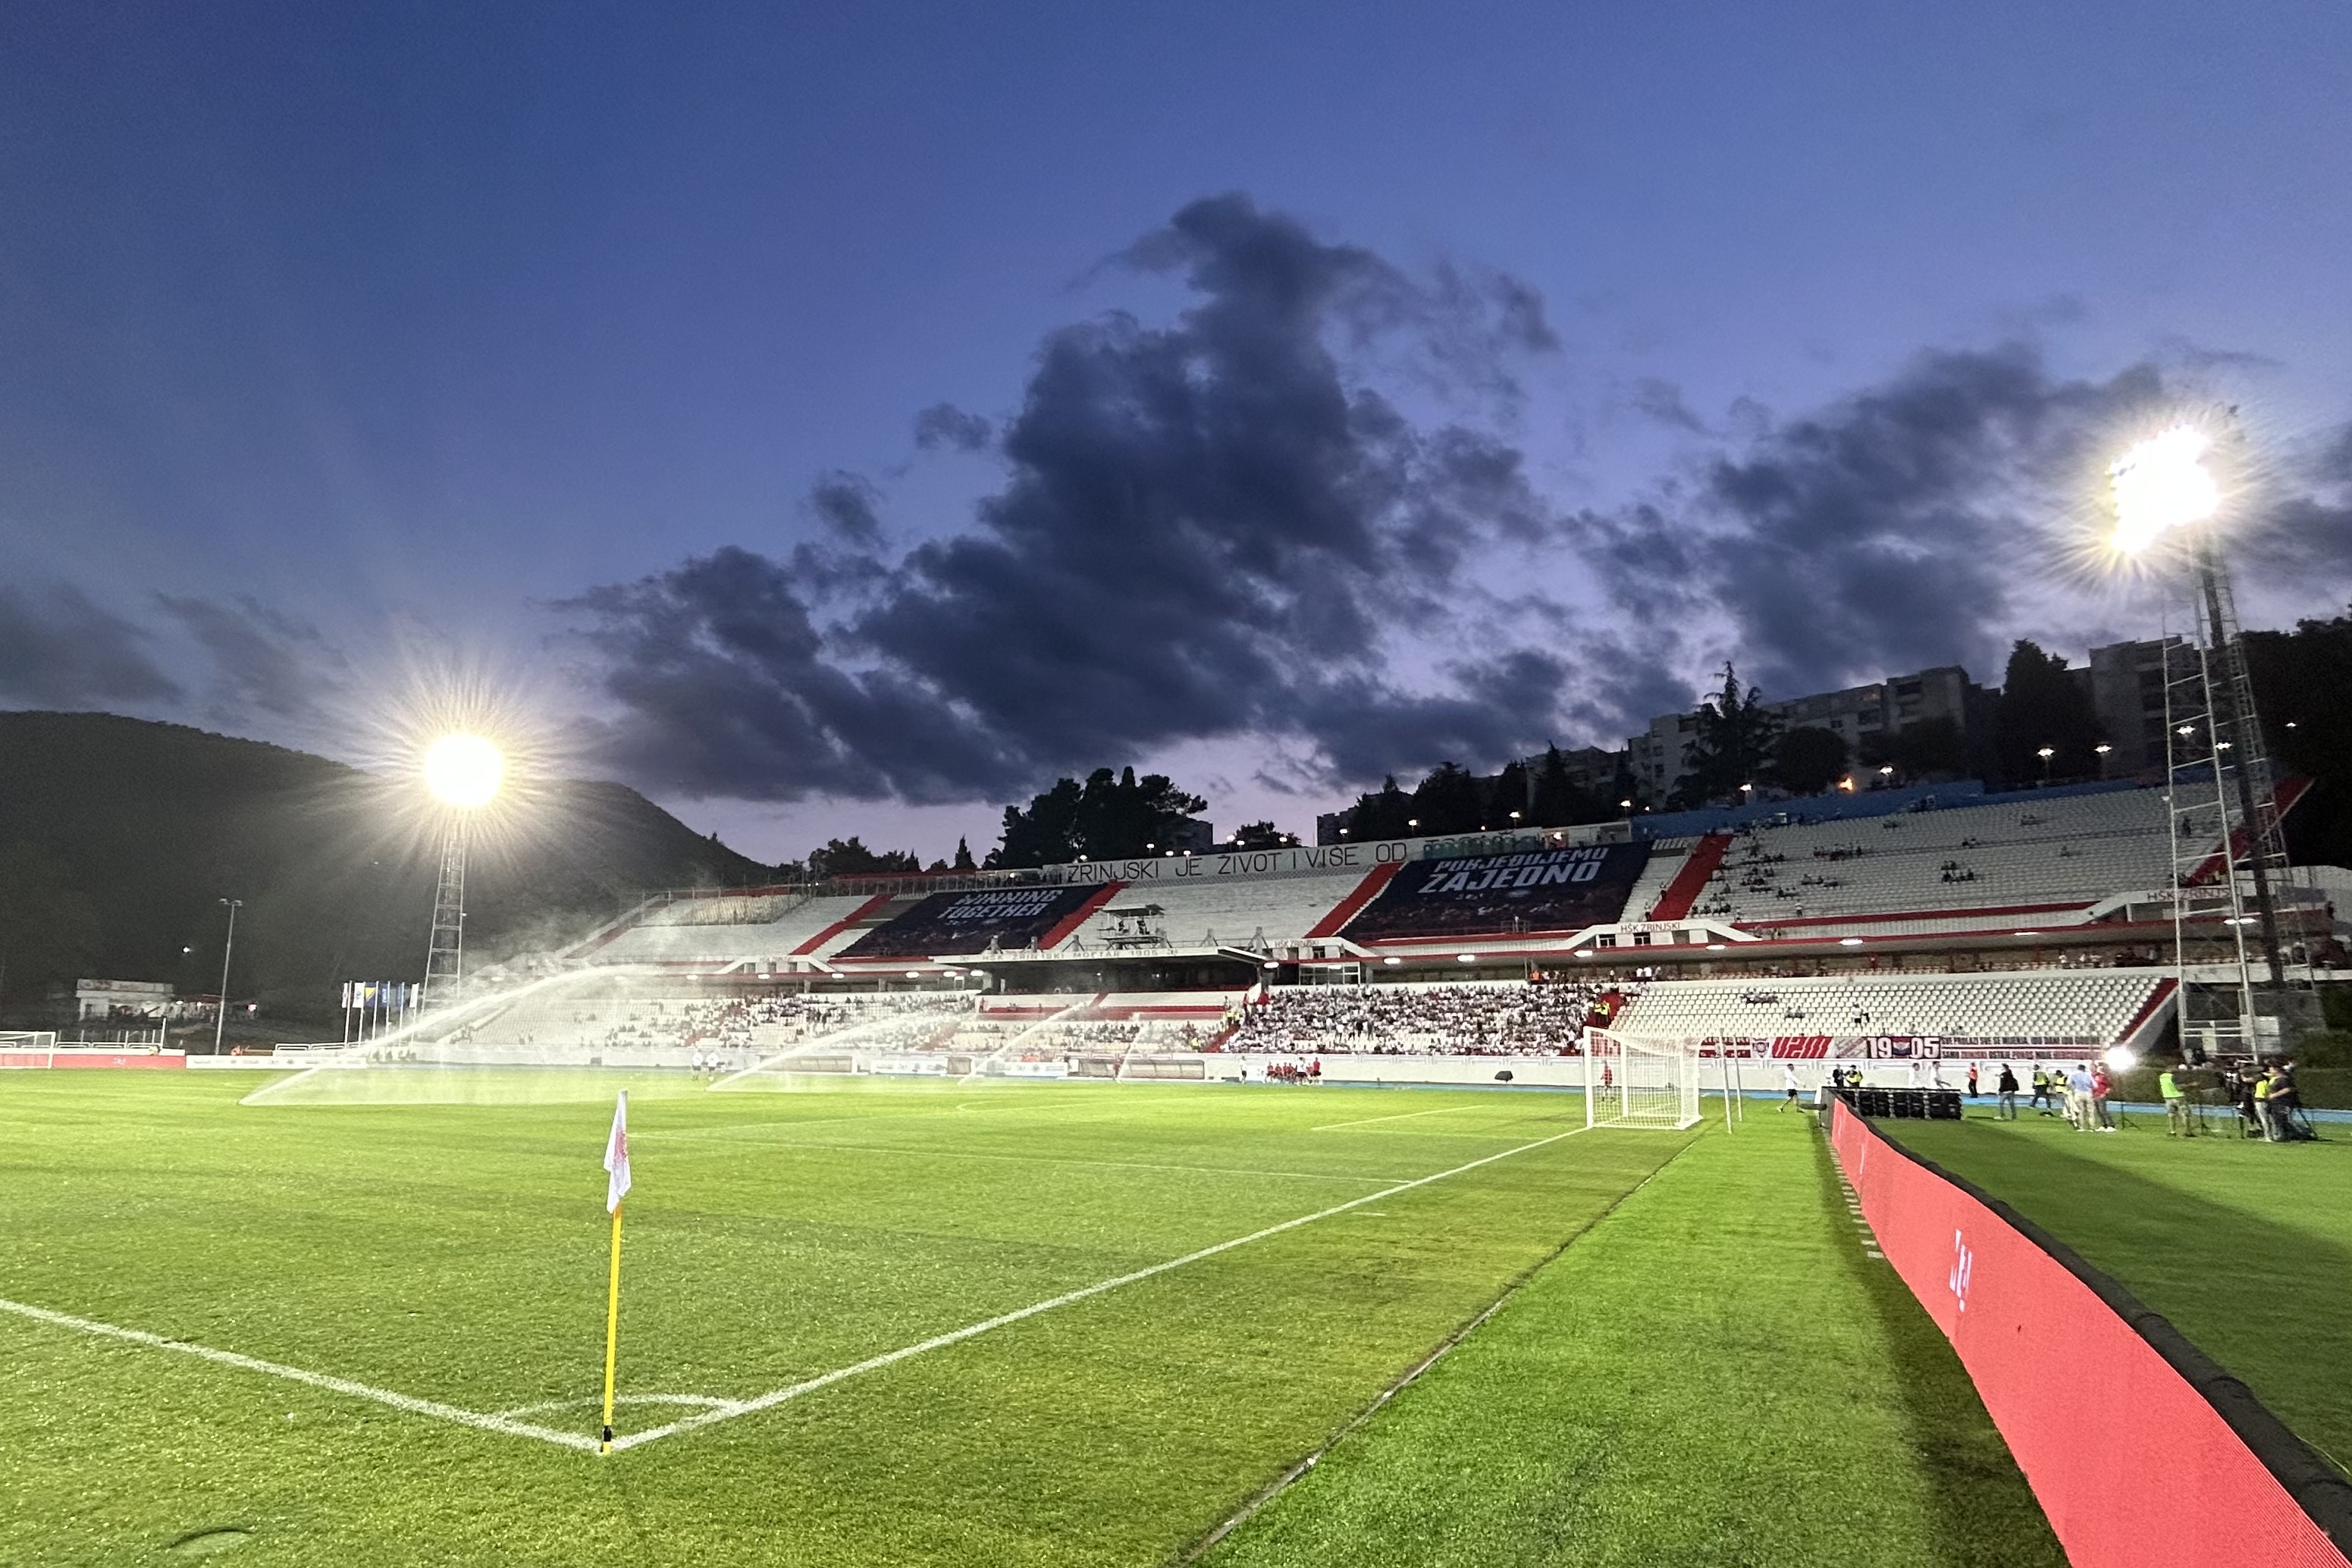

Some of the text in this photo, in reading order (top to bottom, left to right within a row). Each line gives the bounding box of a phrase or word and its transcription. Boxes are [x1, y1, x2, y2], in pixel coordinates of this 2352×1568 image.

[1067, 860, 1159, 883] ZRINJSKI
[1175, 858, 1203, 877] JE
[1306, 845, 1359, 868] VIŠE
[1375, 842, 1406, 862] OD
[1418, 861, 1601, 893] ZAJEDNO
[955, 889, 1063, 905] WINNING
[937, 903, 1048, 919] TOGETHER
[1642, 921, 1680, 933] ZRINJSKI
[1867, 1036, 1940, 1058] 19 05
